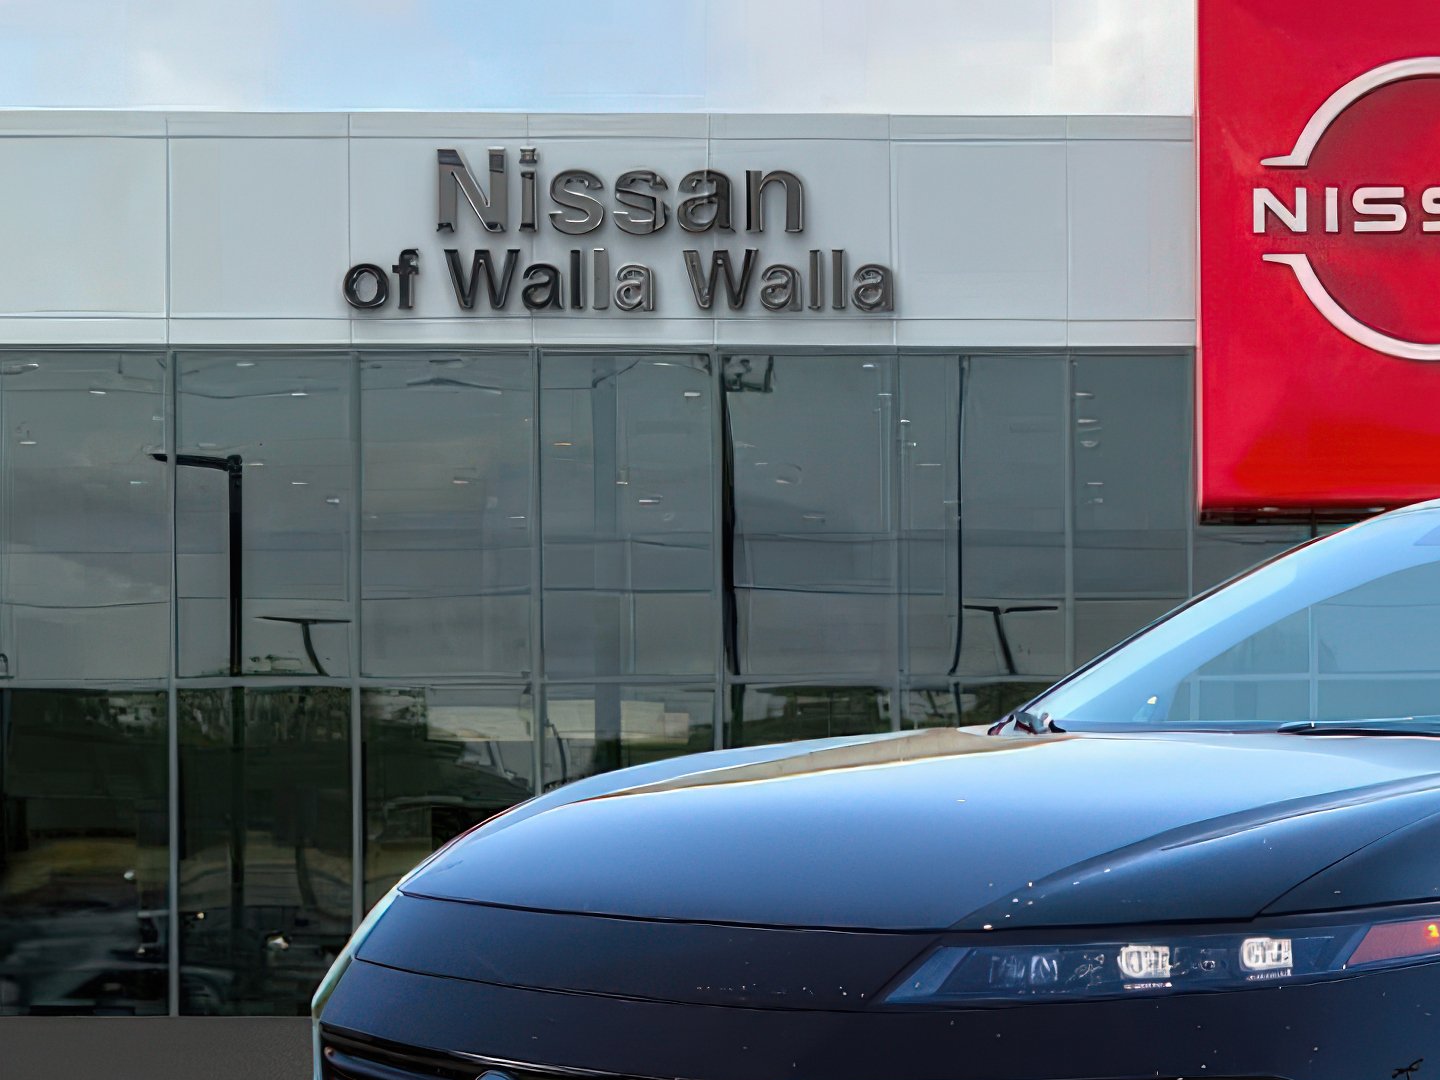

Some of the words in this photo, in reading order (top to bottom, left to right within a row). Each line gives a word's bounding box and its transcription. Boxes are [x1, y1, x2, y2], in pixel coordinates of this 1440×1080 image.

[436, 146, 804, 235] Nissan
[342, 248, 420, 310] of
[444, 248, 657, 312] Walla
[682, 248, 894, 312] Walla
